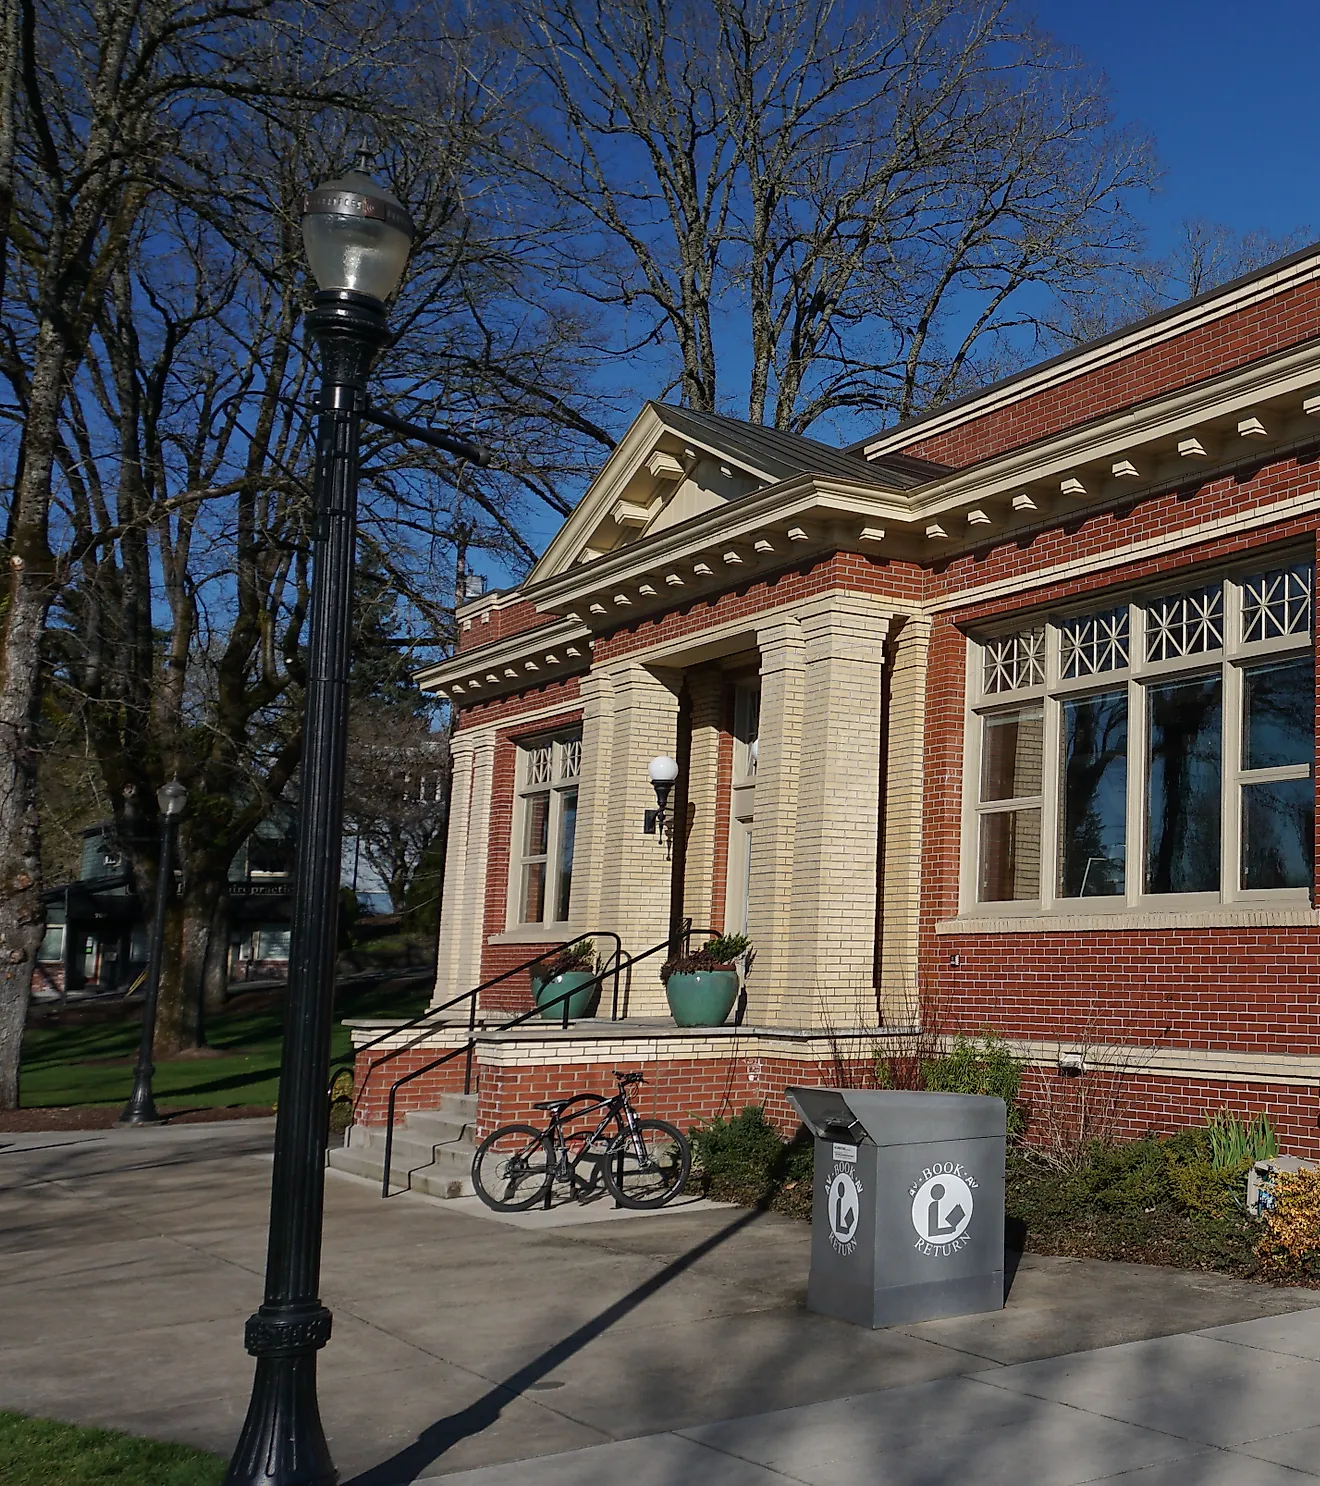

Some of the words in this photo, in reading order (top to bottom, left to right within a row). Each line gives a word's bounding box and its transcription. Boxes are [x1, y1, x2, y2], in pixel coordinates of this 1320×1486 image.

[833, 1161, 856, 1180] BOOK
[908, 1180, 919, 1197] AV
[922, 1161, 964, 1180] BOOK
[965, 1176, 979, 1189] AV
[828, 1231, 858, 1257] RETURN
[914, 1231, 972, 1257] RETURN
